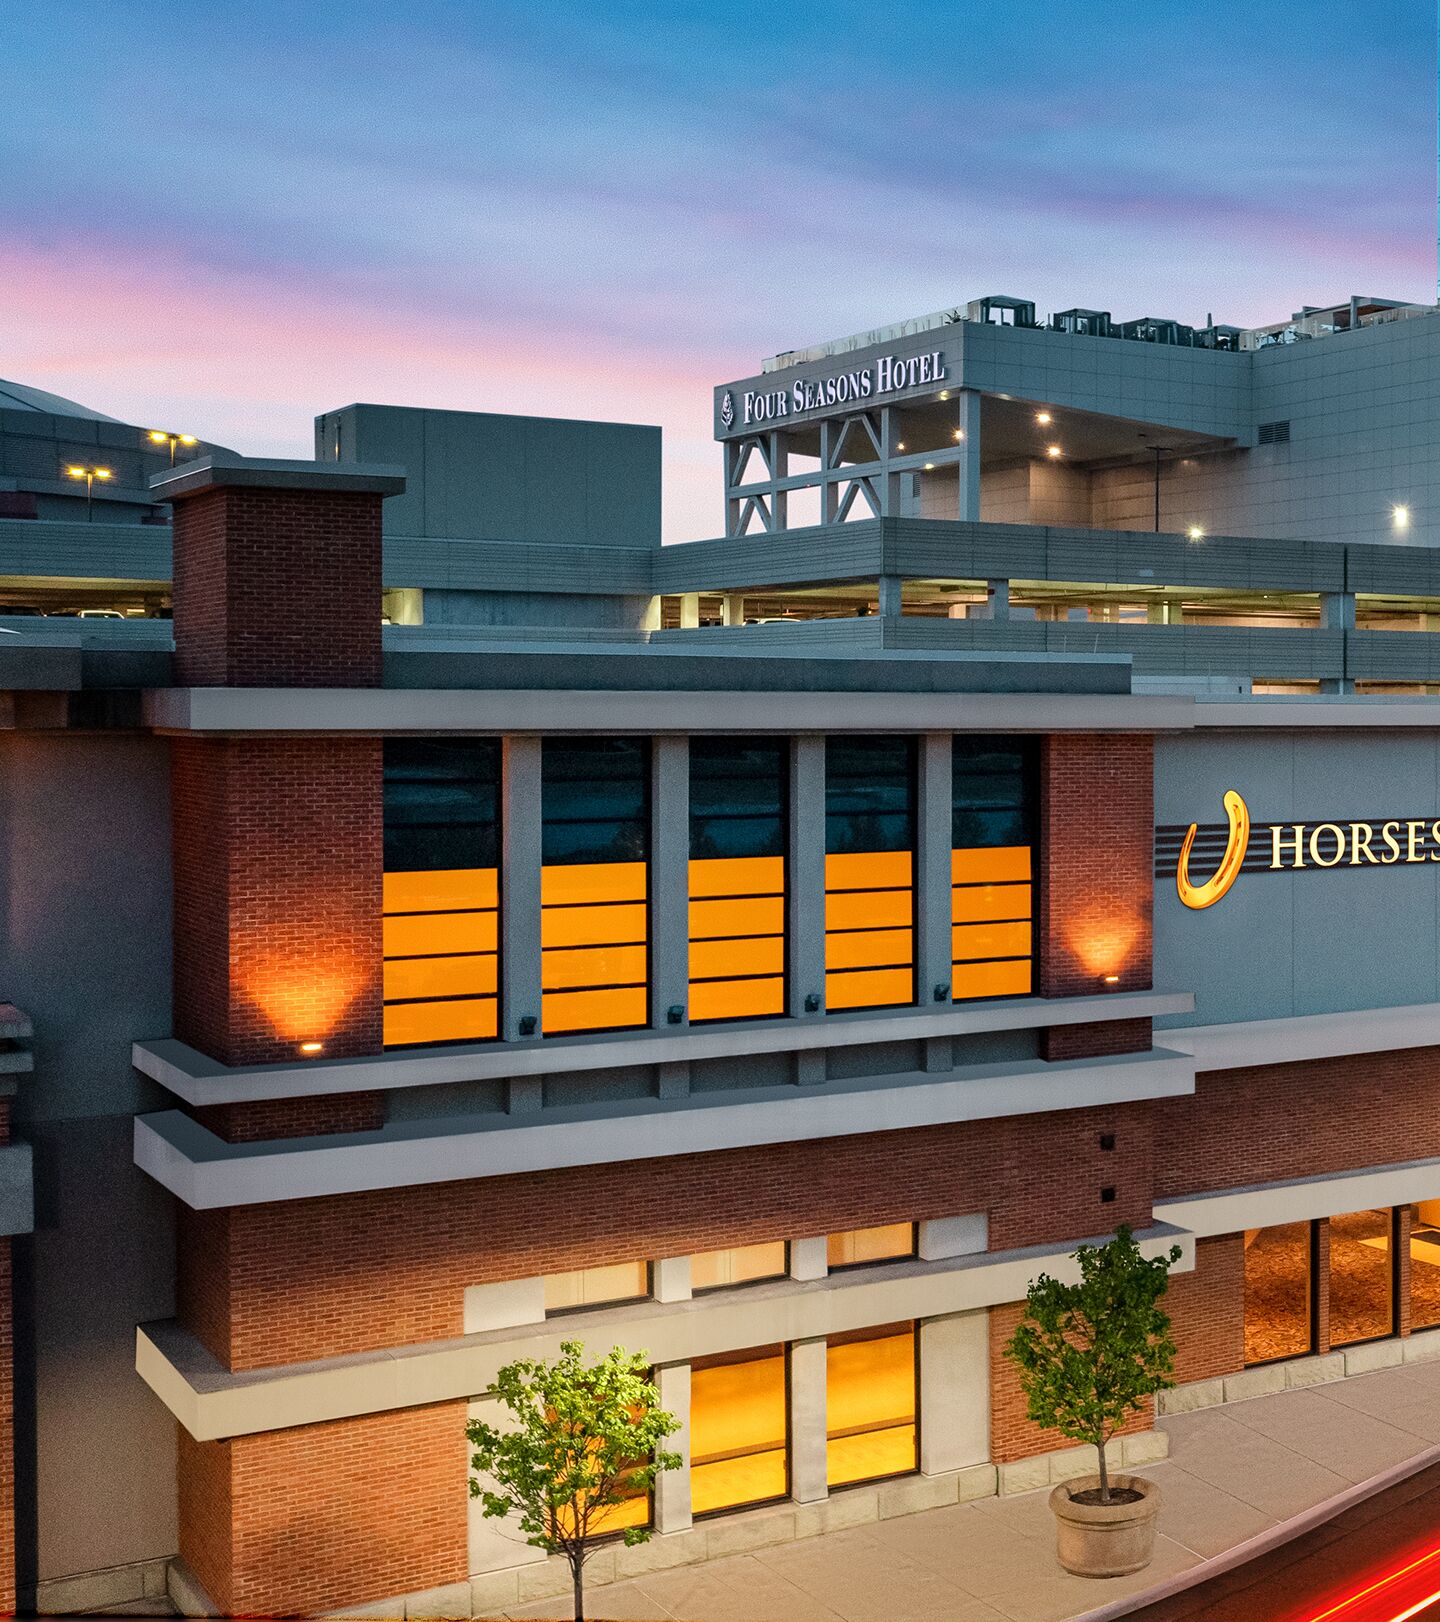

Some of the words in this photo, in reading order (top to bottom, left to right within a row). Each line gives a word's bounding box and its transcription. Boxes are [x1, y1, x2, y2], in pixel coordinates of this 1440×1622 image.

[743, 390, 788, 424] FOUR
[793, 368, 872, 413] SEASONS
[876, 351, 946, 394] HOTEL
